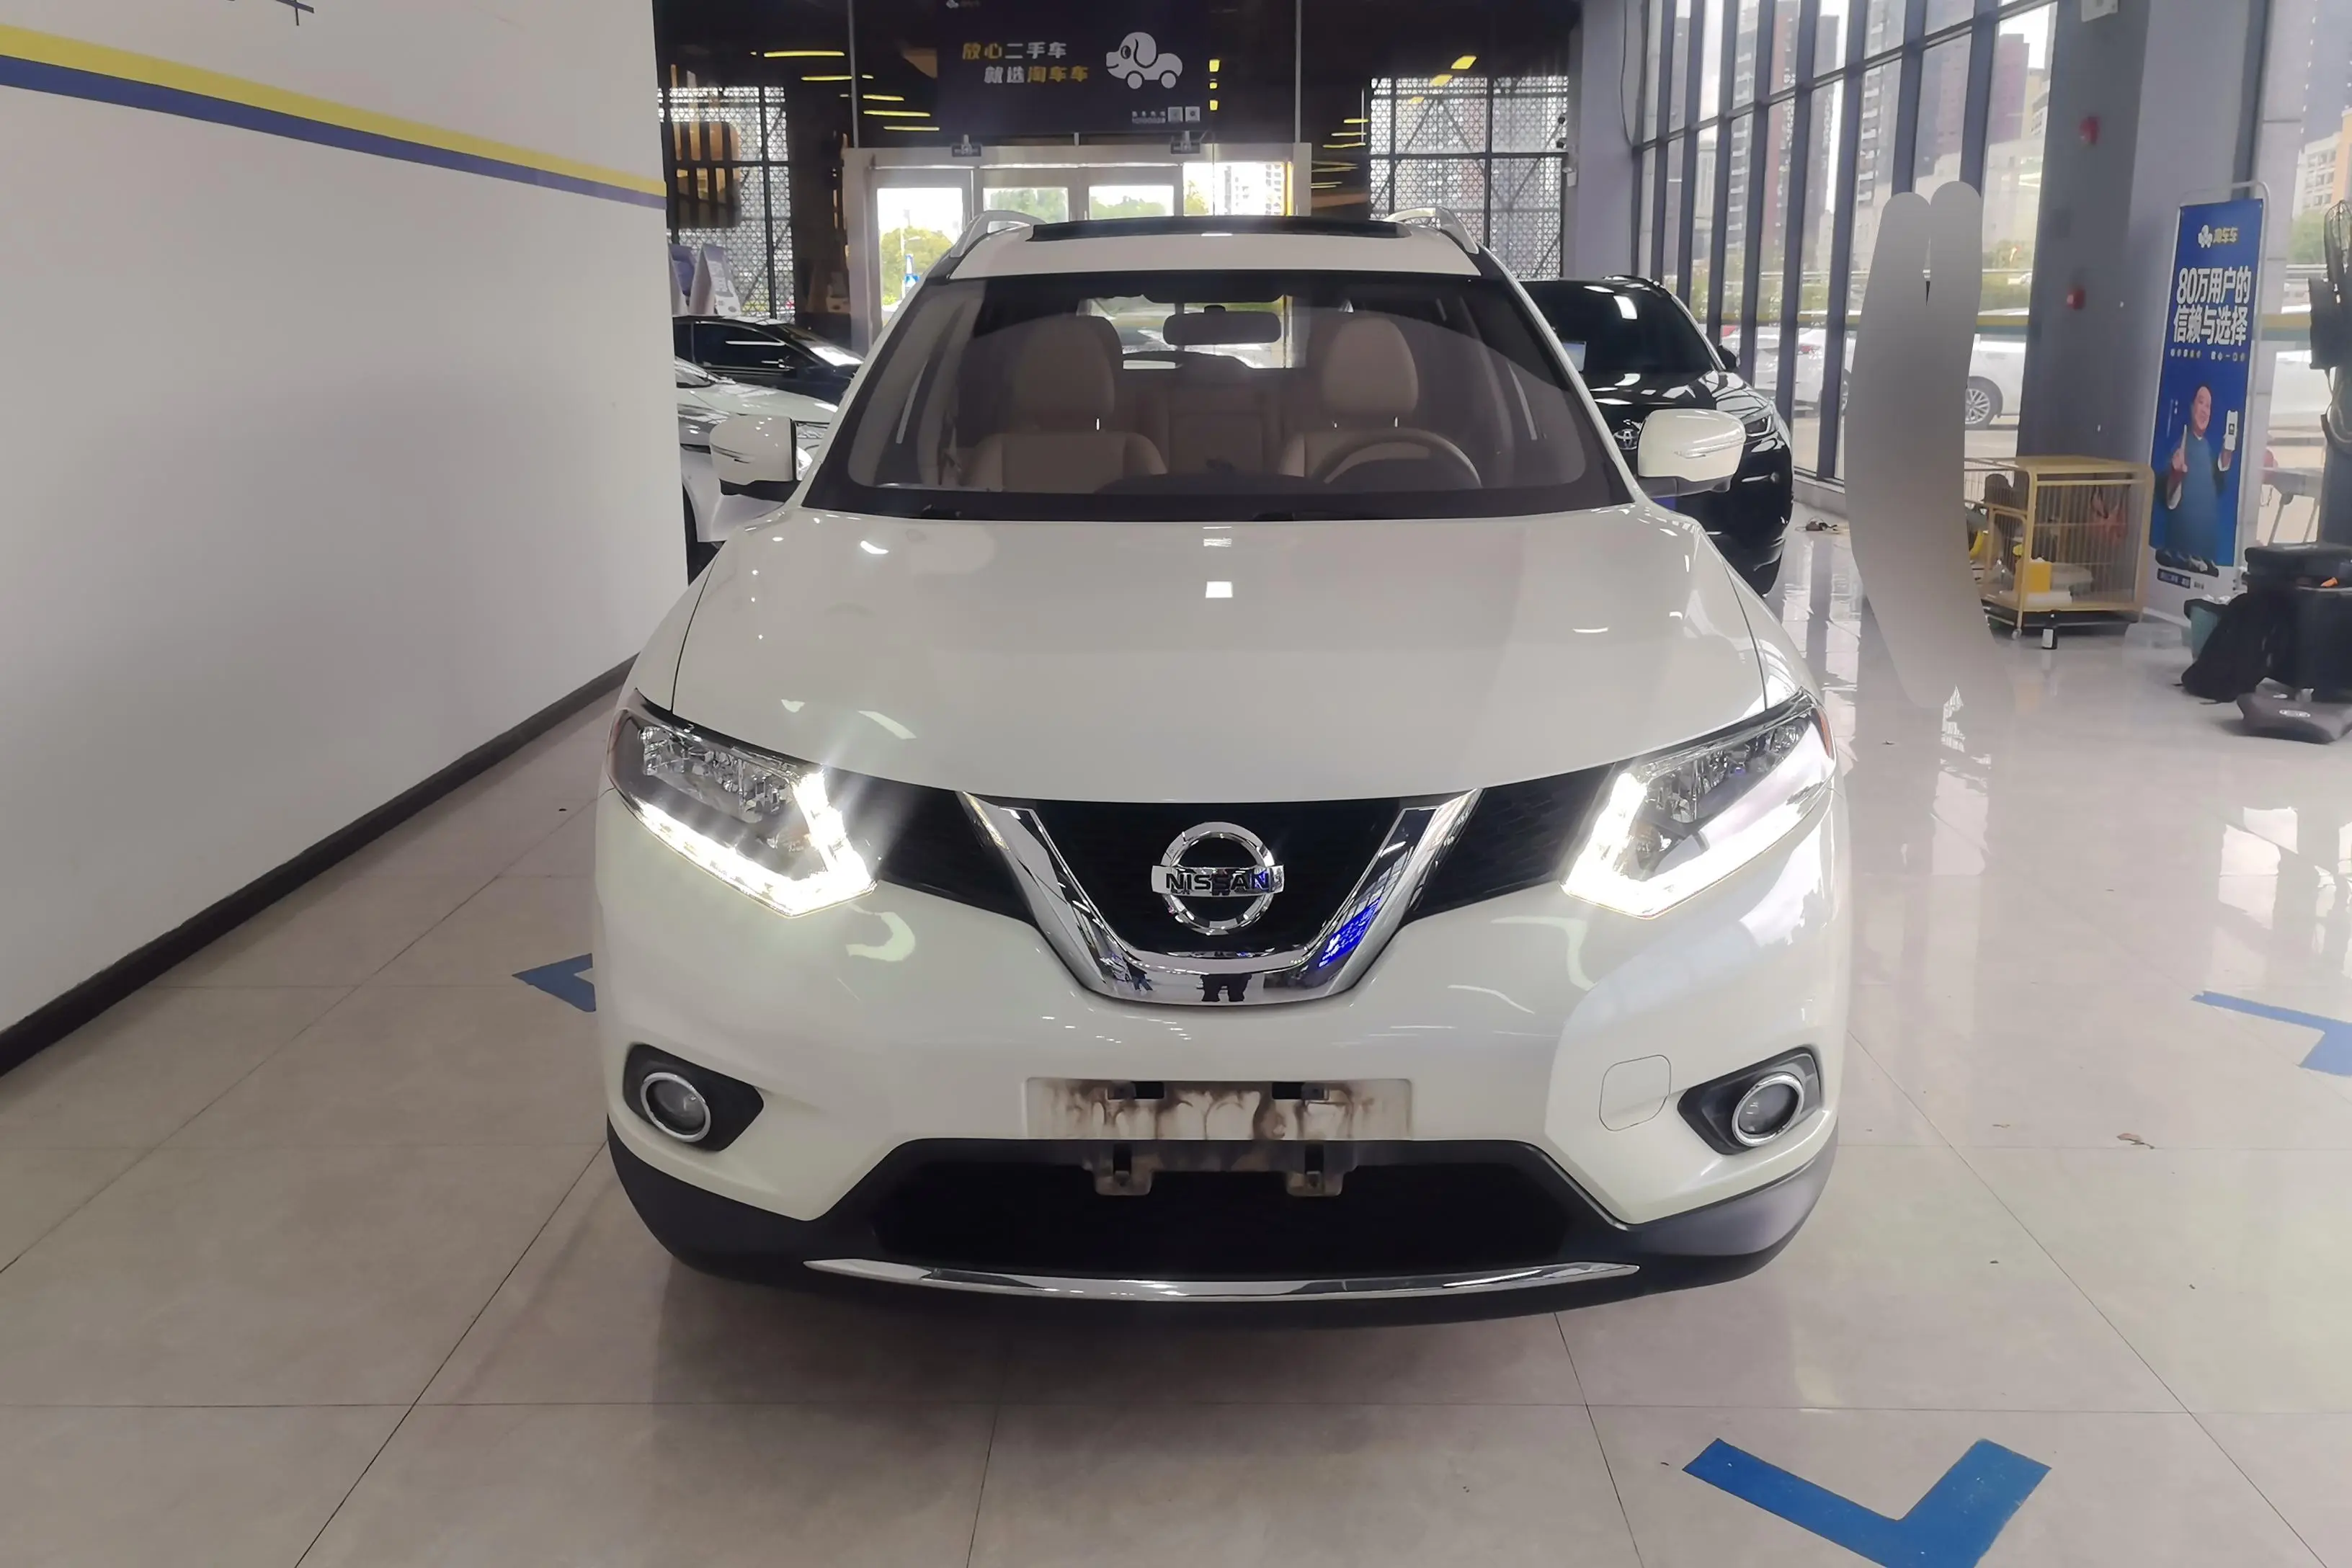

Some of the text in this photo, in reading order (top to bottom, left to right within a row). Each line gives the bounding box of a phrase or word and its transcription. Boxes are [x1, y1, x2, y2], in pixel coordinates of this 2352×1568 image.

[2176, 265, 2252, 304] 80万用户的
[2173, 303, 2248, 347] 信赖与选择
